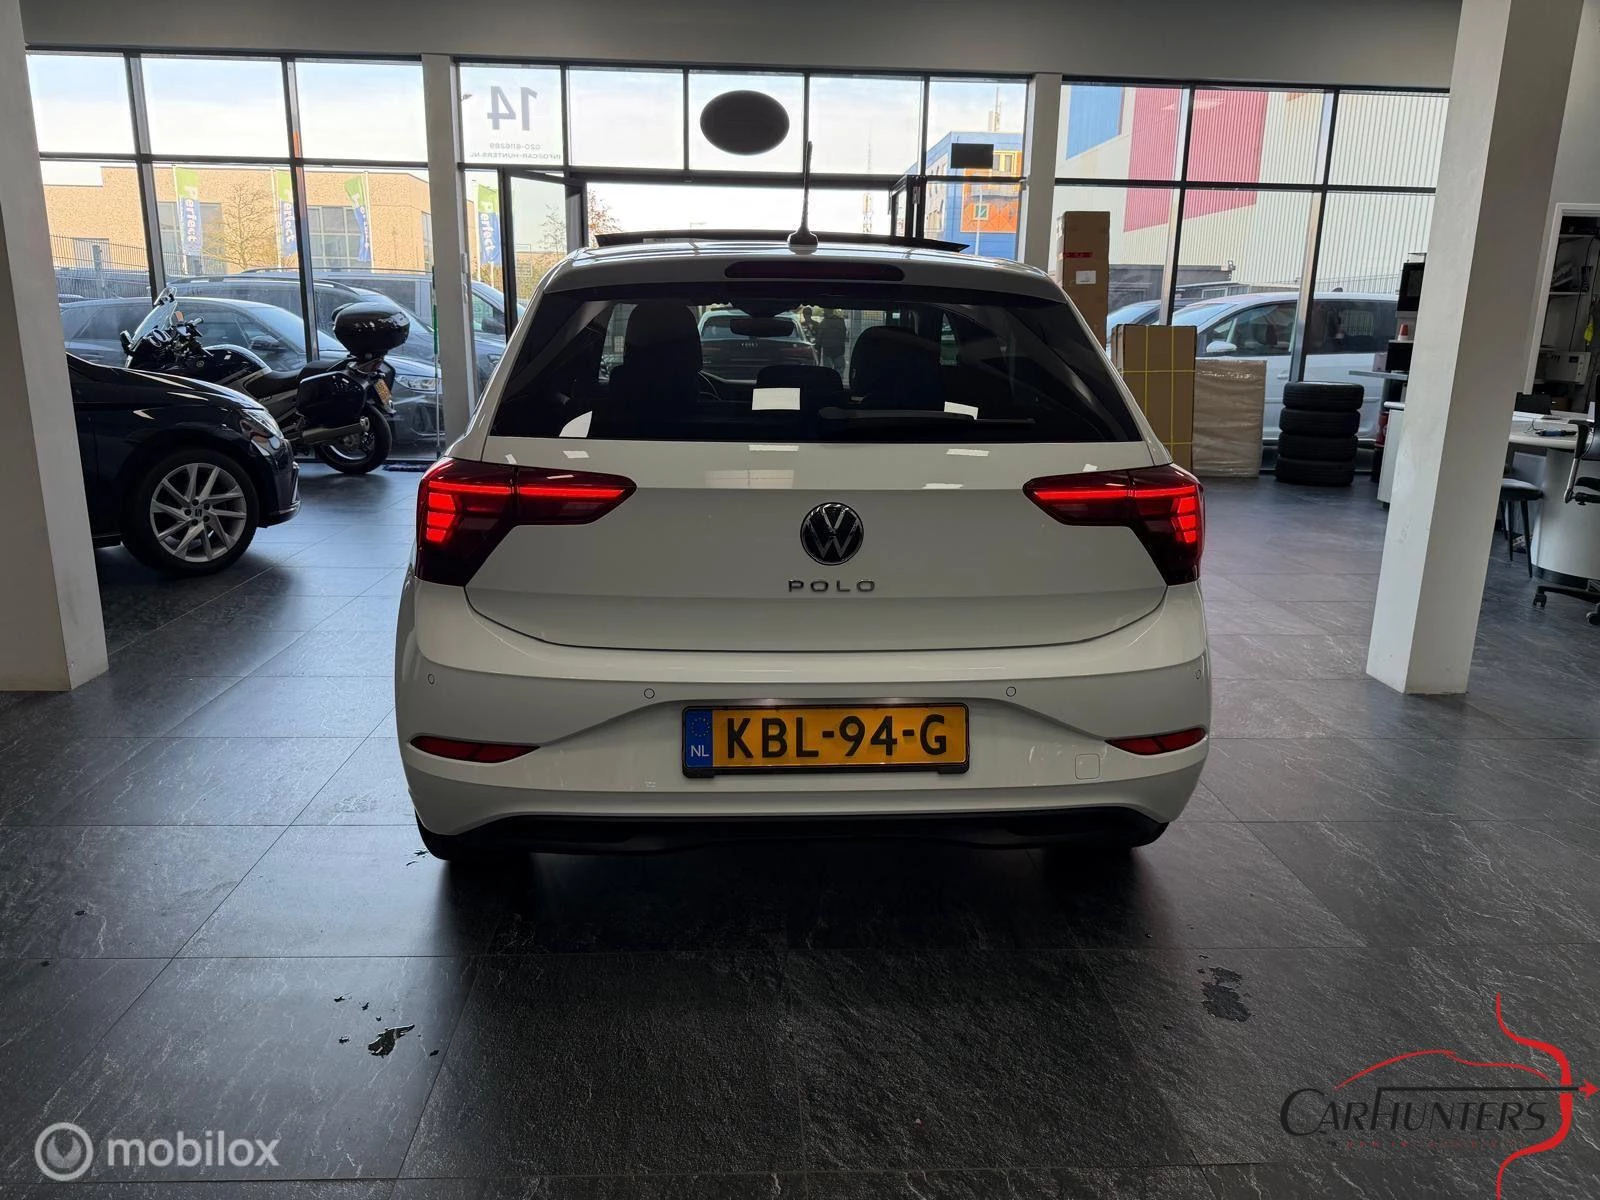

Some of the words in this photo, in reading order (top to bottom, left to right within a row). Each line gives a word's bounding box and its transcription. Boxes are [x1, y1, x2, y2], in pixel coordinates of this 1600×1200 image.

[184, 187, 198, 242] Perfect
[788, 580, 875, 592] POLO
[690, 745, 709, 758] NL
[726, 714, 947, 759] KBL-94-G
